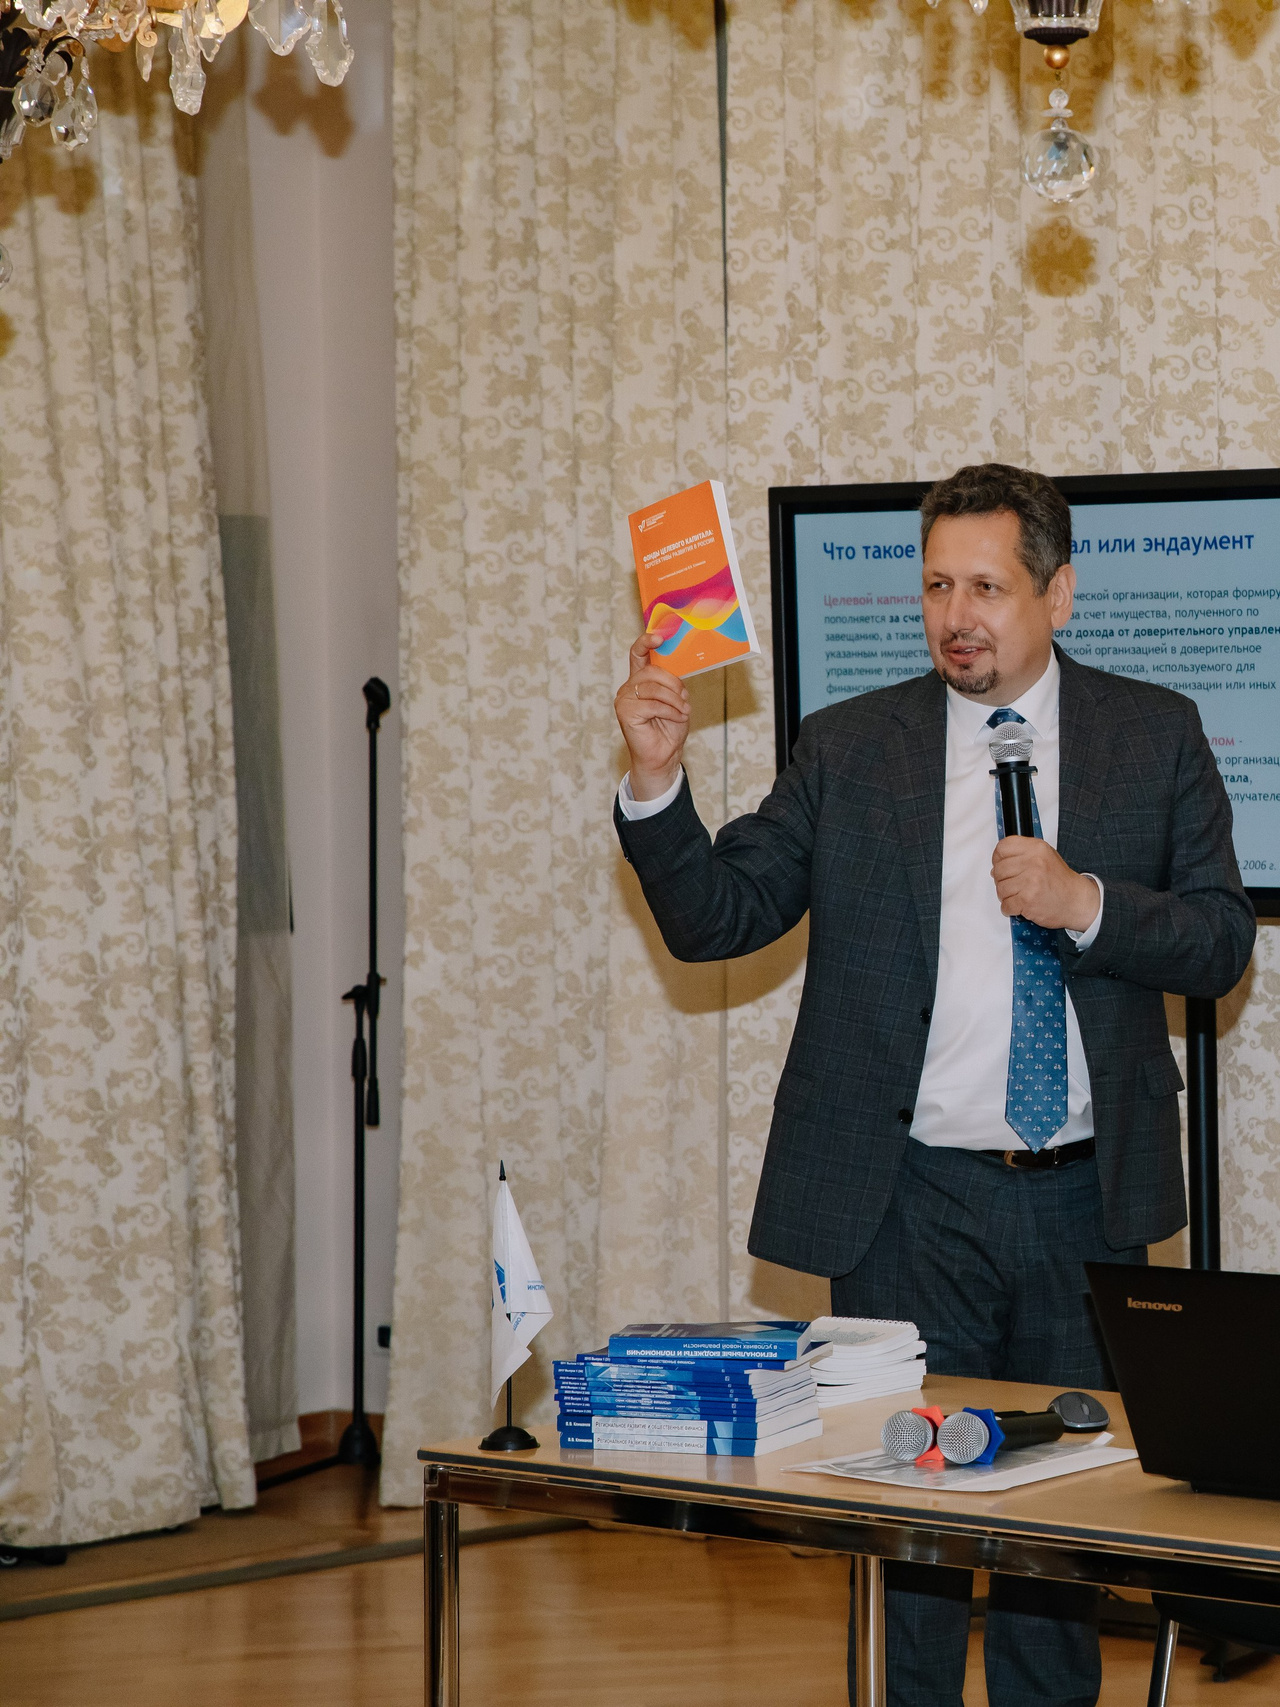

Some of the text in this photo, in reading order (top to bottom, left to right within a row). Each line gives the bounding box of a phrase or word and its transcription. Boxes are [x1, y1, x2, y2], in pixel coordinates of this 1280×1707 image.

[823, 542, 916, 560] Что такое
[1098, 538, 1135, 553] или
[1142, 534, 1255, 556] эндаумент
[824, 593, 873, 608] Целевой
[1112, 590, 1183, 603] организации,
[1186, 589, 1229, 601] которая
[824, 615, 886, 624] пополняется
[889, 615, 900, 623] за
[1083, 610, 1107, 619] счет
[1109, 609, 1171, 621] имущества,
[1174, 608, 1243, 620] полученного
[1246, 608, 1259, 617] по
[825, 632, 925, 642] завещанию, а также
[1075, 629, 1115, 640] дохода
[1118, 628, 1130, 637] от
[1133, 627, 1225, 640] доверительного
[825, 650, 878, 660] указанным
[1094, 643, 1168, 657] организацией
[1170, 645, 1177, 654] в
[1180, 644, 1262, 657] доверительное
[826, 667, 883, 678] управление
[1108, 664, 1149, 675] дохода,
[1152, 662, 1233, 675] используемого
[1236, 663, 1256, 674] для
[1225, 681, 1246, 690] или
[1249, 680, 1277, 690] иных
[1207, 737, 1235, 746] лом
[1126, 1297, 1183, 1312] lenovo
[626, 1349, 676, 1357] ПОЛНОМОЧИЯ
[683, 1350, 721, 1358] БЮДЖЕТЫ
